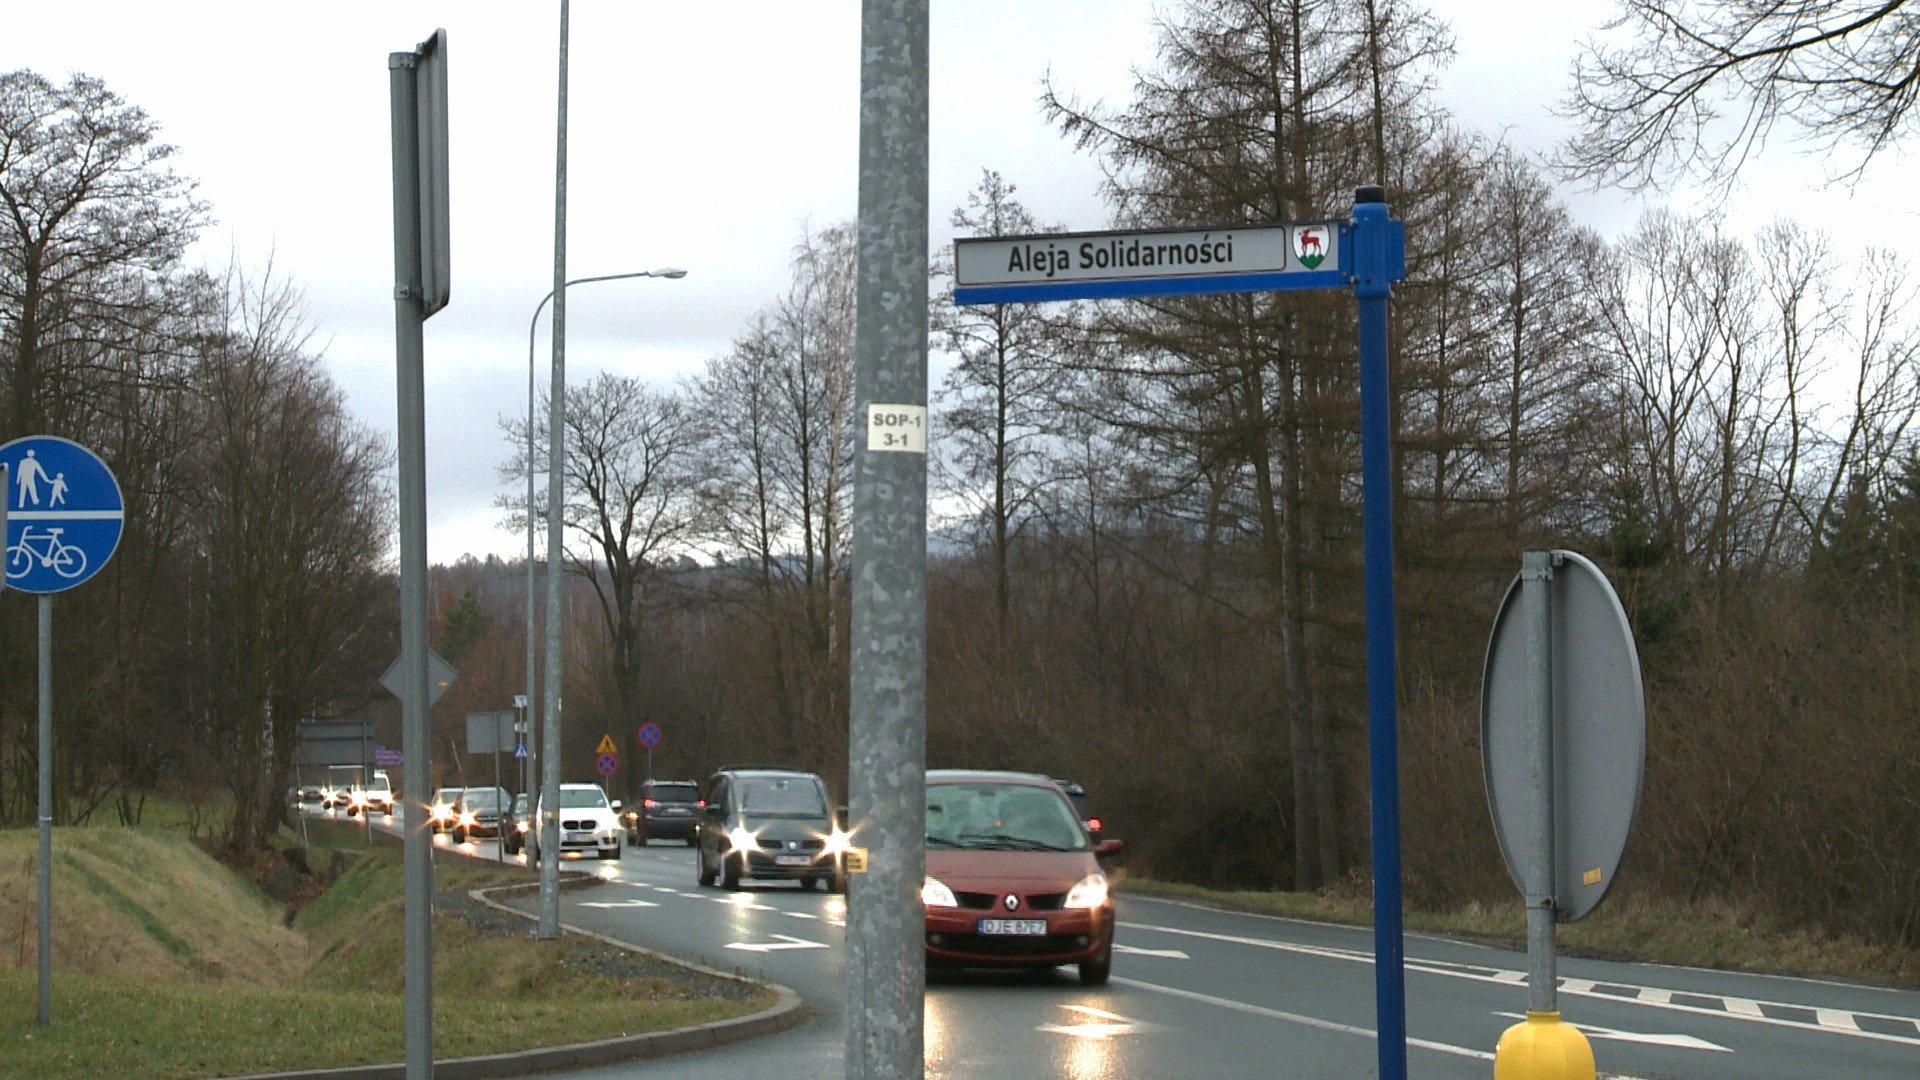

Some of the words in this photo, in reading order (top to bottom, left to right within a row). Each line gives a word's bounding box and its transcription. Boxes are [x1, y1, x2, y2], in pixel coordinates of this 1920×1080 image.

[1008, 246, 1069, 277] Aleja
[1079, 234, 1233, 268] Solidarności
[873, 413, 921, 428] SOP-1
[883, 433, 907, 446] 3-1
